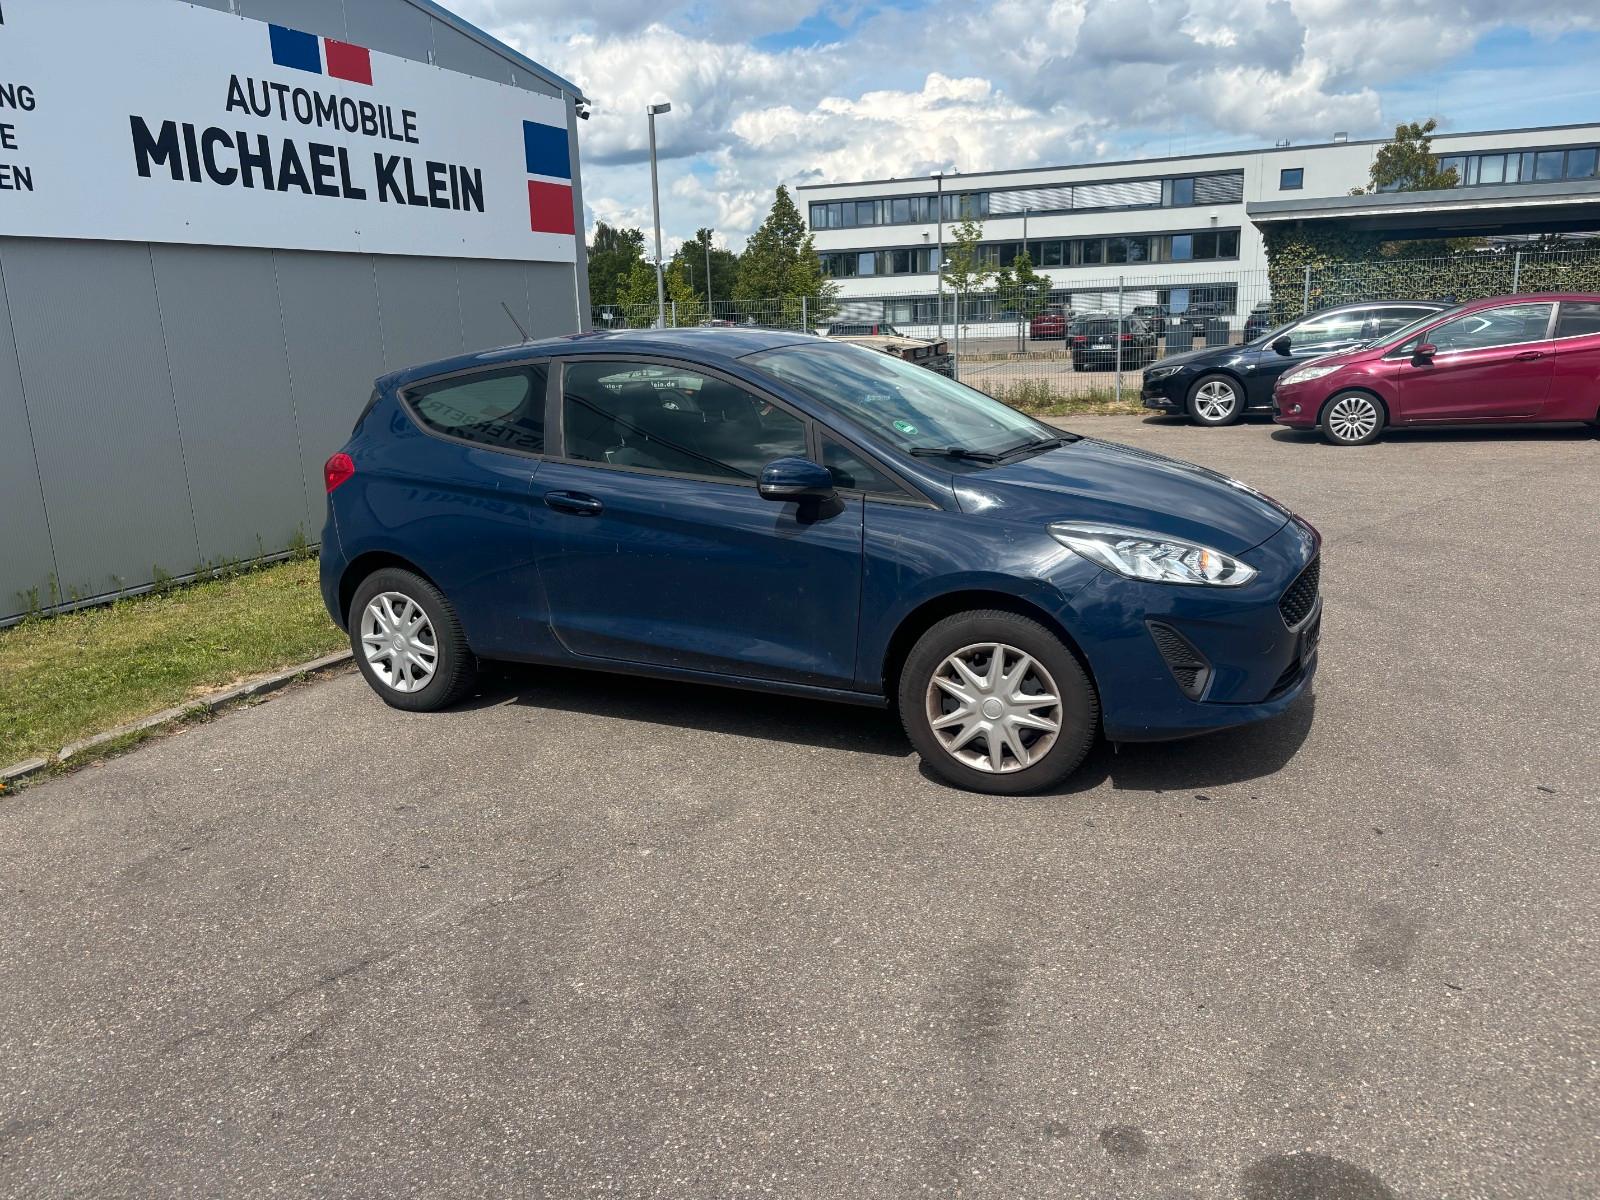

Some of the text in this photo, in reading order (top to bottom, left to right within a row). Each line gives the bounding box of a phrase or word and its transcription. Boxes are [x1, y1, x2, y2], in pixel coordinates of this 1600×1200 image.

[226, 74, 419, 144] AUTOMOBILE
[129, 115, 485, 213] MICHAEL KLEIN
